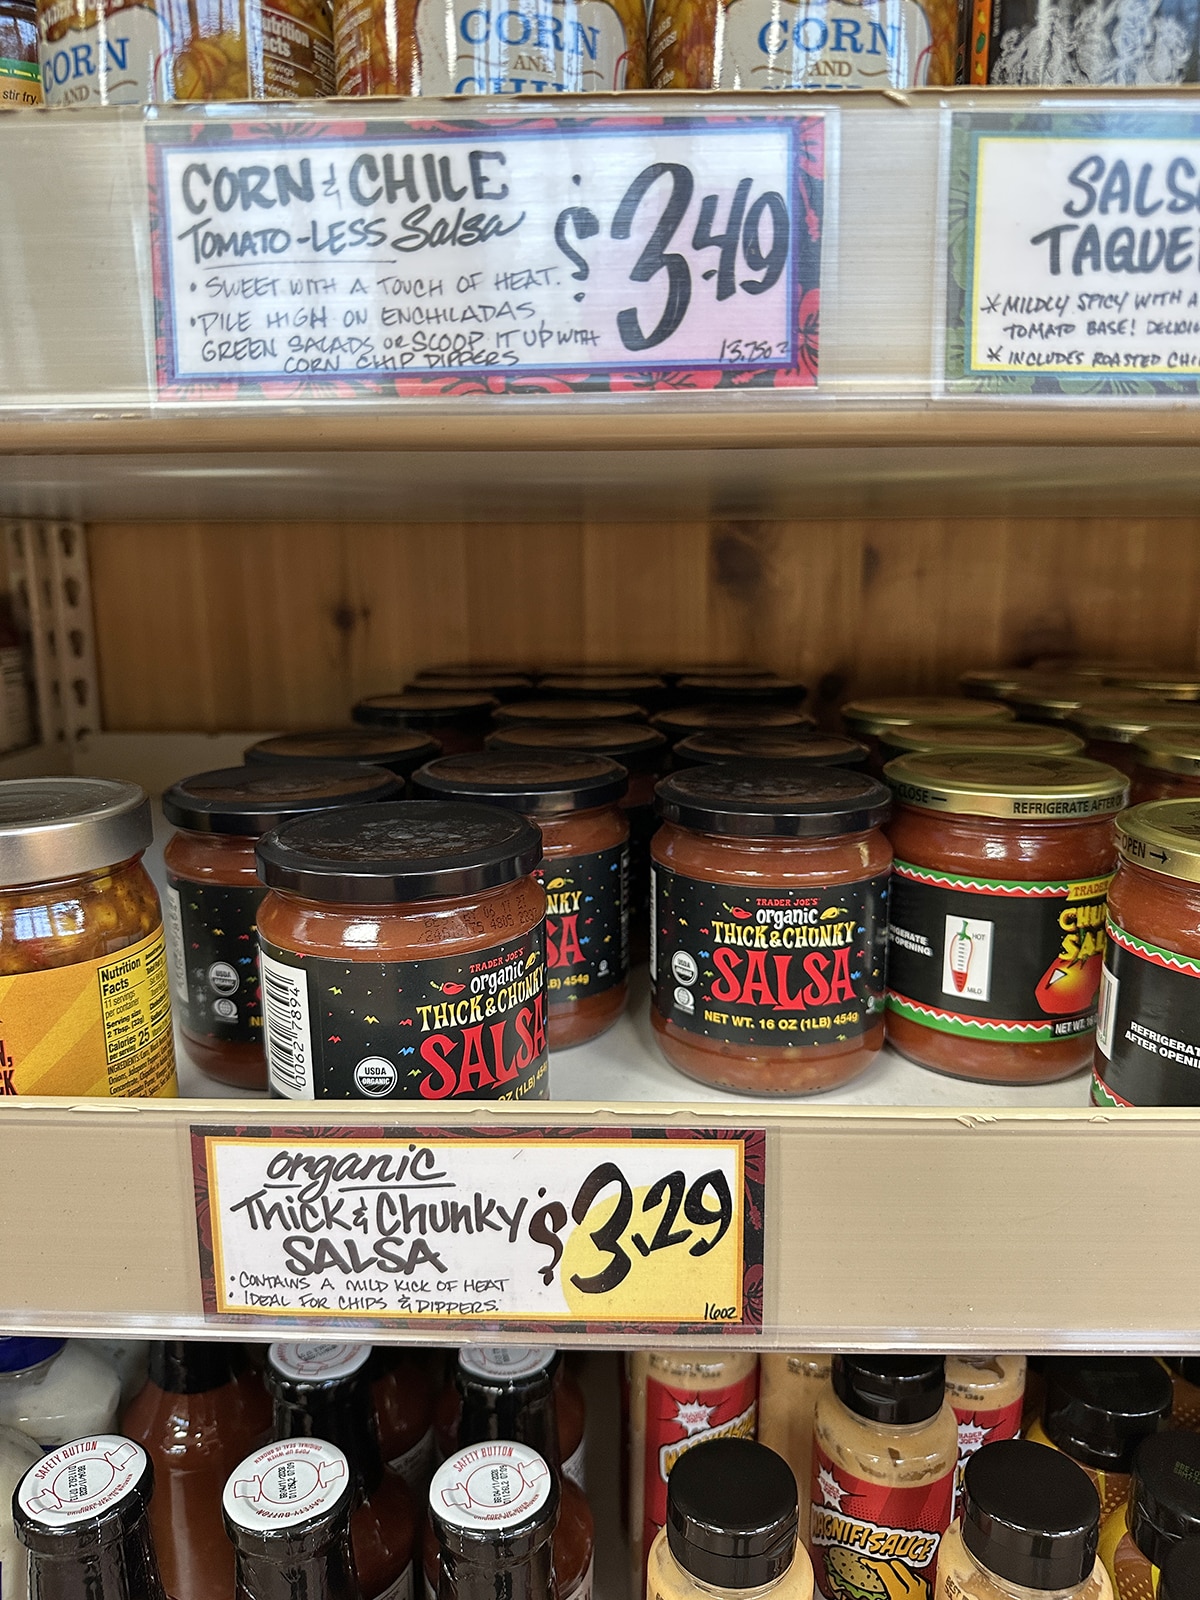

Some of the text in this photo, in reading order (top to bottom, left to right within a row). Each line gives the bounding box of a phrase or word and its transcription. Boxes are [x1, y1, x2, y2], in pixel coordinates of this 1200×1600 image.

[262, 16, 309, 48] utrition
[460, 9, 601, 60] CORN
[757, 17, 901, 58] CORN
[263, 35, 291, 57] acts
[42, 38, 130, 94] CORN
[809, 61, 852, 77] AND
[2, 90, 39, 105] stir fry.
[182, 157, 314, 215] CORN
[349, 149, 509, 207] CHILE
[1063, 155, 1200, 218] SALS
[391, 204, 526, 253] Salsa
[1030, 224, 1200, 276] TAQUE
[205, 265, 562, 299] SWEET WITH A TOUCH OF HEAT.
[1002, 290, 1199, 318] MILDLY SPICY WITH A
[198, 302, 536, 337] PILE HIGH ON ENCHILADAS
[1003, 319, 1136, 340] TOMATO BASE!
[201, 337, 278, 363] GREEN
[287, 335, 375, 357] SALADS
[411, 331, 484, 354] SCOOP
[495, 329, 521, 349] IT
[521, 319, 555, 348] UP
[555, 328, 601, 348] WITH
[284, 349, 520, 375] CORN CHIP DIPPERS
[1008, 350, 1200, 368] INCLUDES ROASTED CHI
[1013, 797, 1115, 815] REFRIGERATE AFTER
[1121, 833, 1147, 859] OPEN
[756, 897, 819, 907] TRADER JOE'S
[755, 907, 819, 930] organic
[895, 936, 934, 957] OPENING
[971, 933, 986, 941] HOT
[101, 957, 142, 982] Nutrition
[469, 947, 525, 974] TRADER JOE'S
[103, 978, 130, 997] Facts
[469, 959, 524, 995] organic
[563, 973, 590, 986] 454g
[710, 946, 857, 1011] SALSA
[104, 999, 113, 1009] 11
[113, 989, 136, 1006] servings
[966, 986, 983, 995] MILD
[105, 1008, 116, 1020] per
[116, 997, 140, 1015] container
[106, 1008, 142, 1029] Serving size
[704, 1010, 860, 1032] NET WT. 16 OZ (1LB) 454g
[1055, 1021, 1071, 1035] NET
[107, 1030, 113, 1039] 2
[108, 1027, 150, 1054] Calories 25
[1125, 1030, 1158, 1054] AFTER
[419, 994, 547, 1100] SALSA
[361, 1076, 391, 1086] ORGANIC
[364, 1066, 387, 1075] USDA
[265, 1143, 448, 1202] organic
[282, 1235, 449, 1276] SALSA
[239, 1271, 510, 1293] CONTAINS A MILD KICK OF HEAT
[243, 1290, 291, 1308] IDEAL
[299, 1293, 331, 1310] FOR
[338, 1294, 388, 1311] CHIPS
[958, 1431, 983, 1440] RADER
[34, 1453, 63, 1480] SAFETY
[62, 1440, 98, 1459] BUTTON
[285, 1449, 294, 1458] UP
[453, 1449, 479, 1473] SAFETY
[481, 1445, 514, 1458] BUTTON
